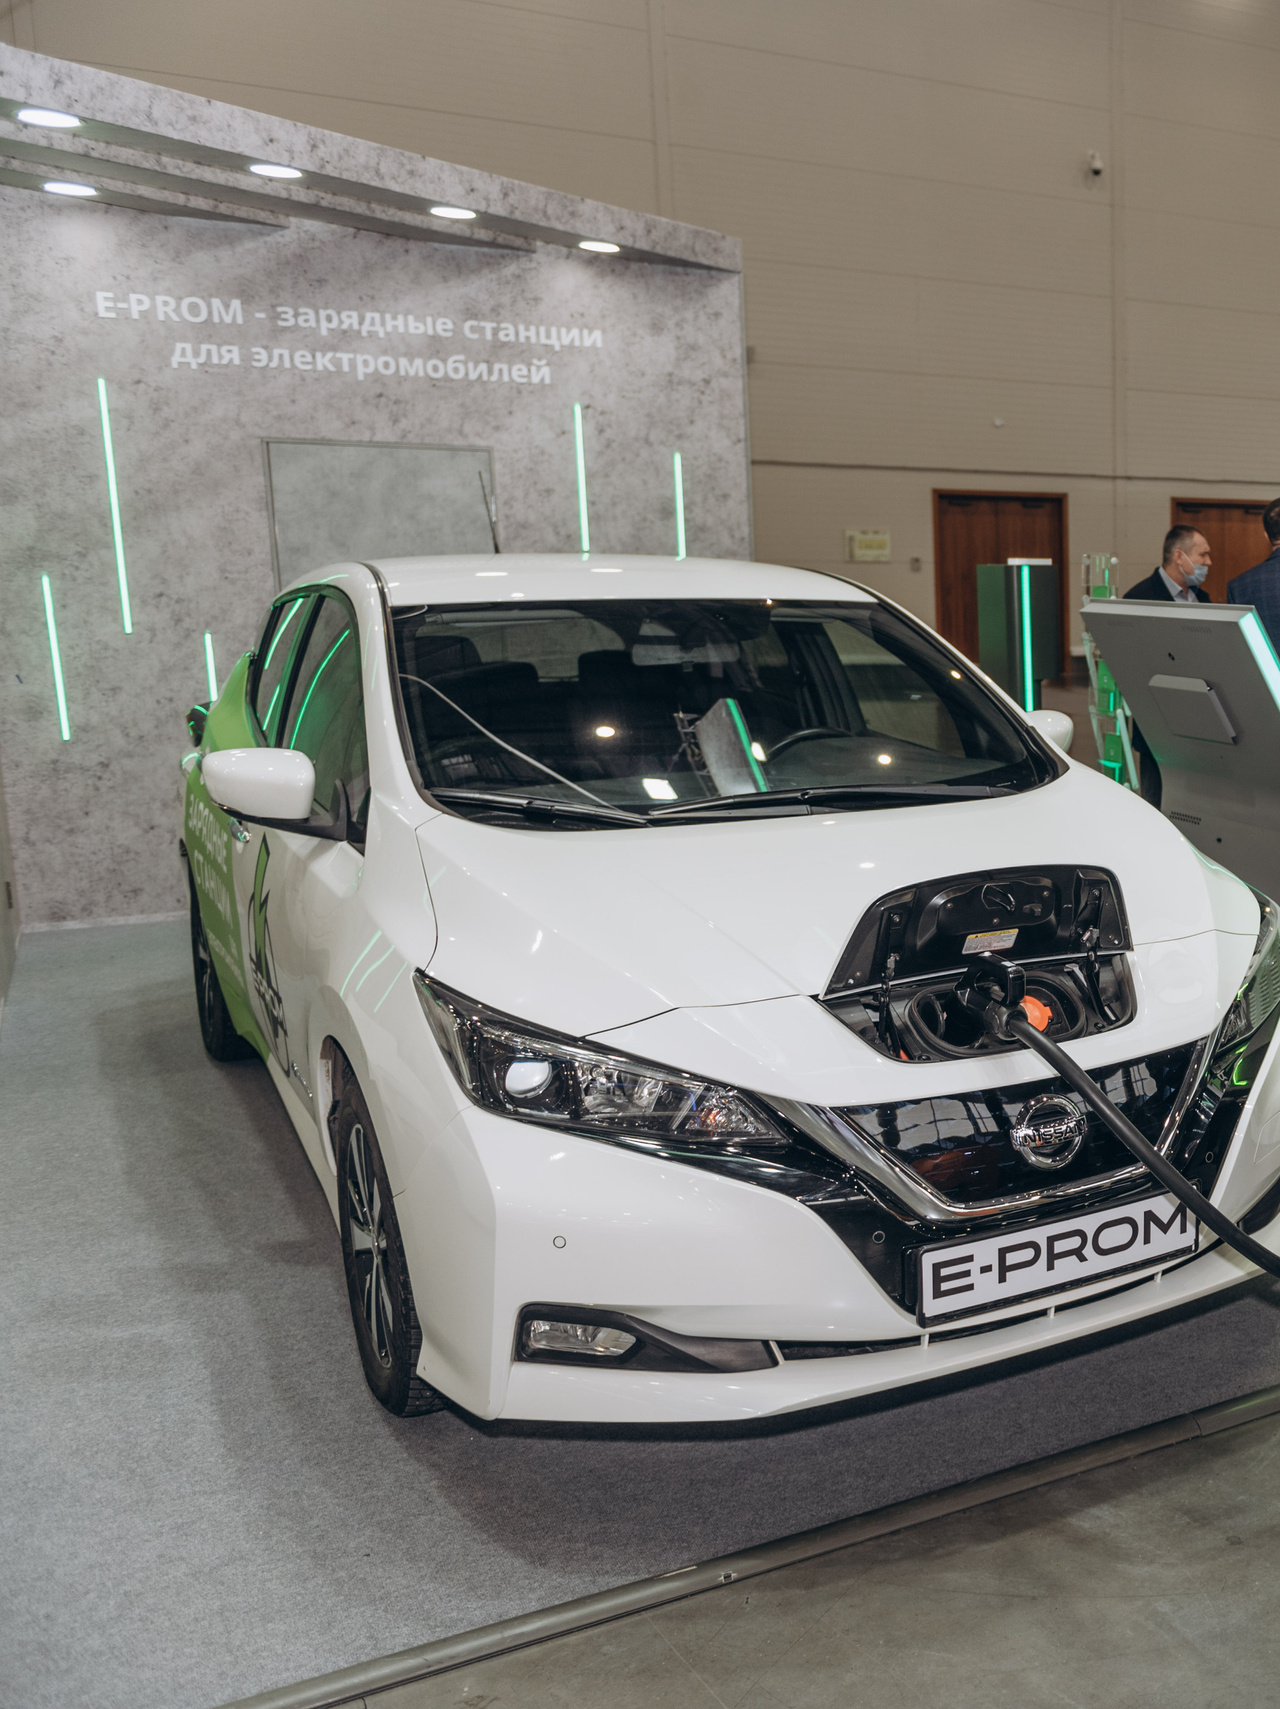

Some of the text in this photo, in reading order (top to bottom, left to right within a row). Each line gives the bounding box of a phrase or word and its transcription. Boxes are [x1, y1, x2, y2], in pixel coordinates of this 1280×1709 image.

[96, 291, 603, 351] E-PROM - зарядные станции
[171, 342, 551, 385] для электромобилей
[1022, 1118, 1085, 1147] NISSAN
[932, 1202, 1188, 1300] E-PROM
